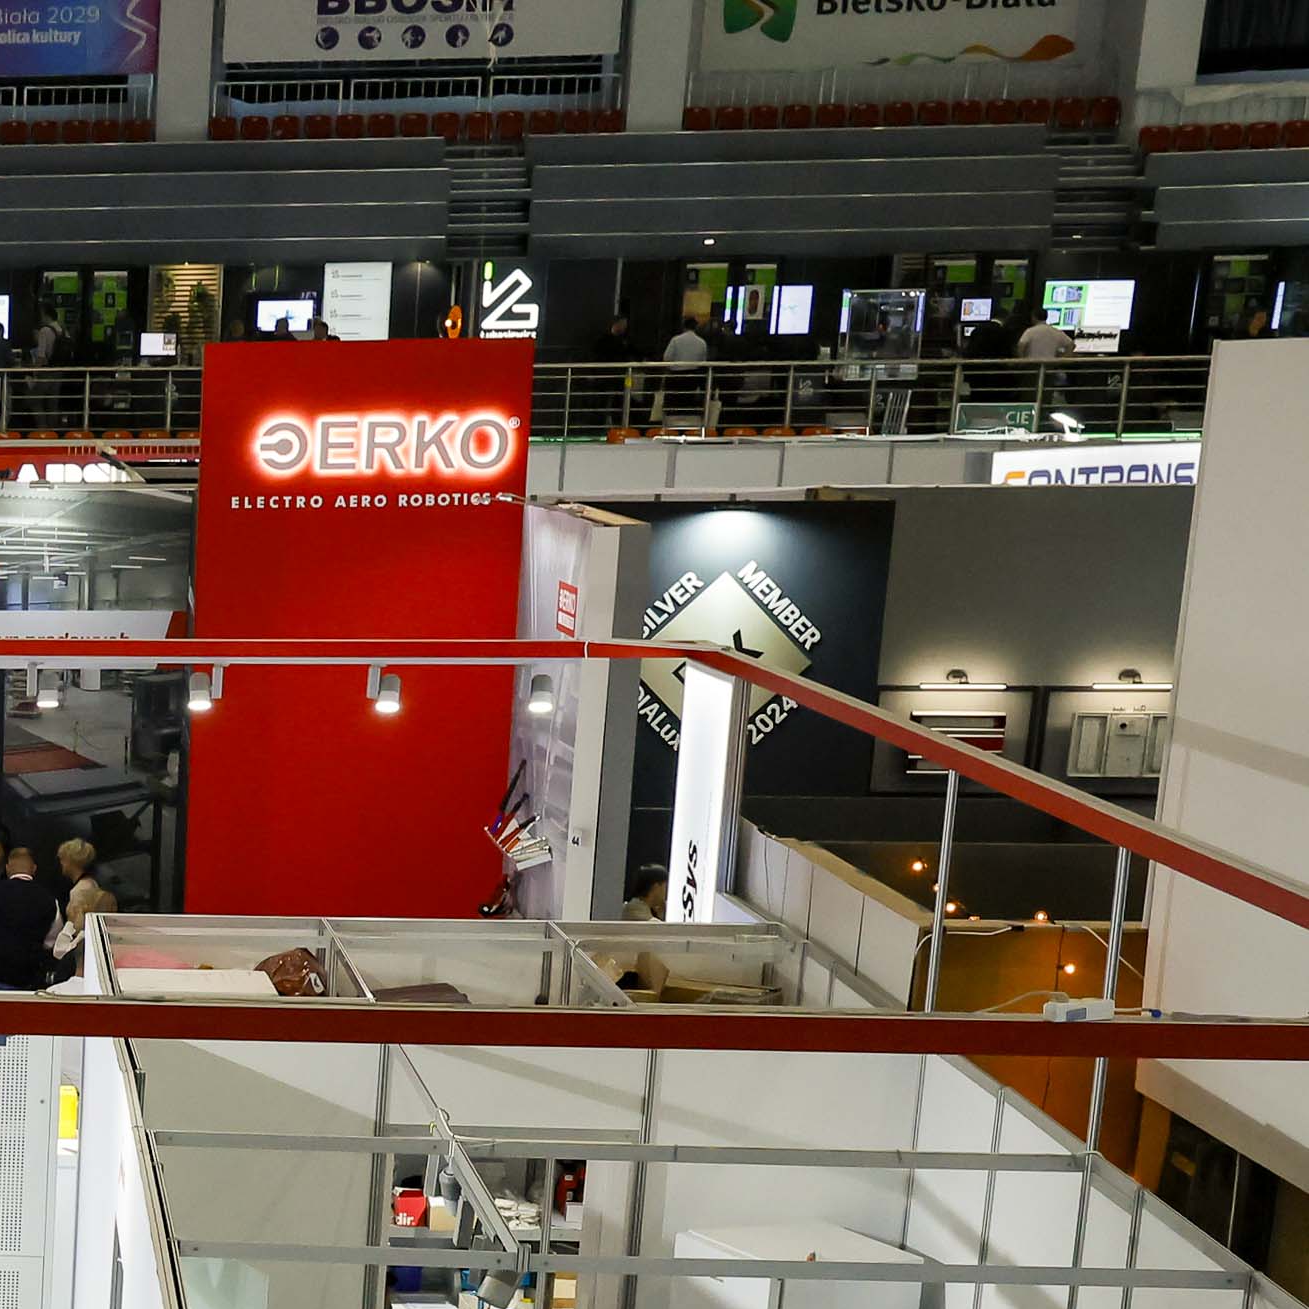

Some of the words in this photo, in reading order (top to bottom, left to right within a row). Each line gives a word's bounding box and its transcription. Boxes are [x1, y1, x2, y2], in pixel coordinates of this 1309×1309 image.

[47, 7, 101, 24] 2029
[32, 29, 82, 46] kultury
[318, 418, 509, 471] ERKO
[231, 496, 324, 509] ELECTRO
[335, 495, 387, 508] AERO
[398, 492, 492, 507] ROBOTICS
[737, 560, 822, 650] MEMBER
[746, 694, 798, 745] 2024
